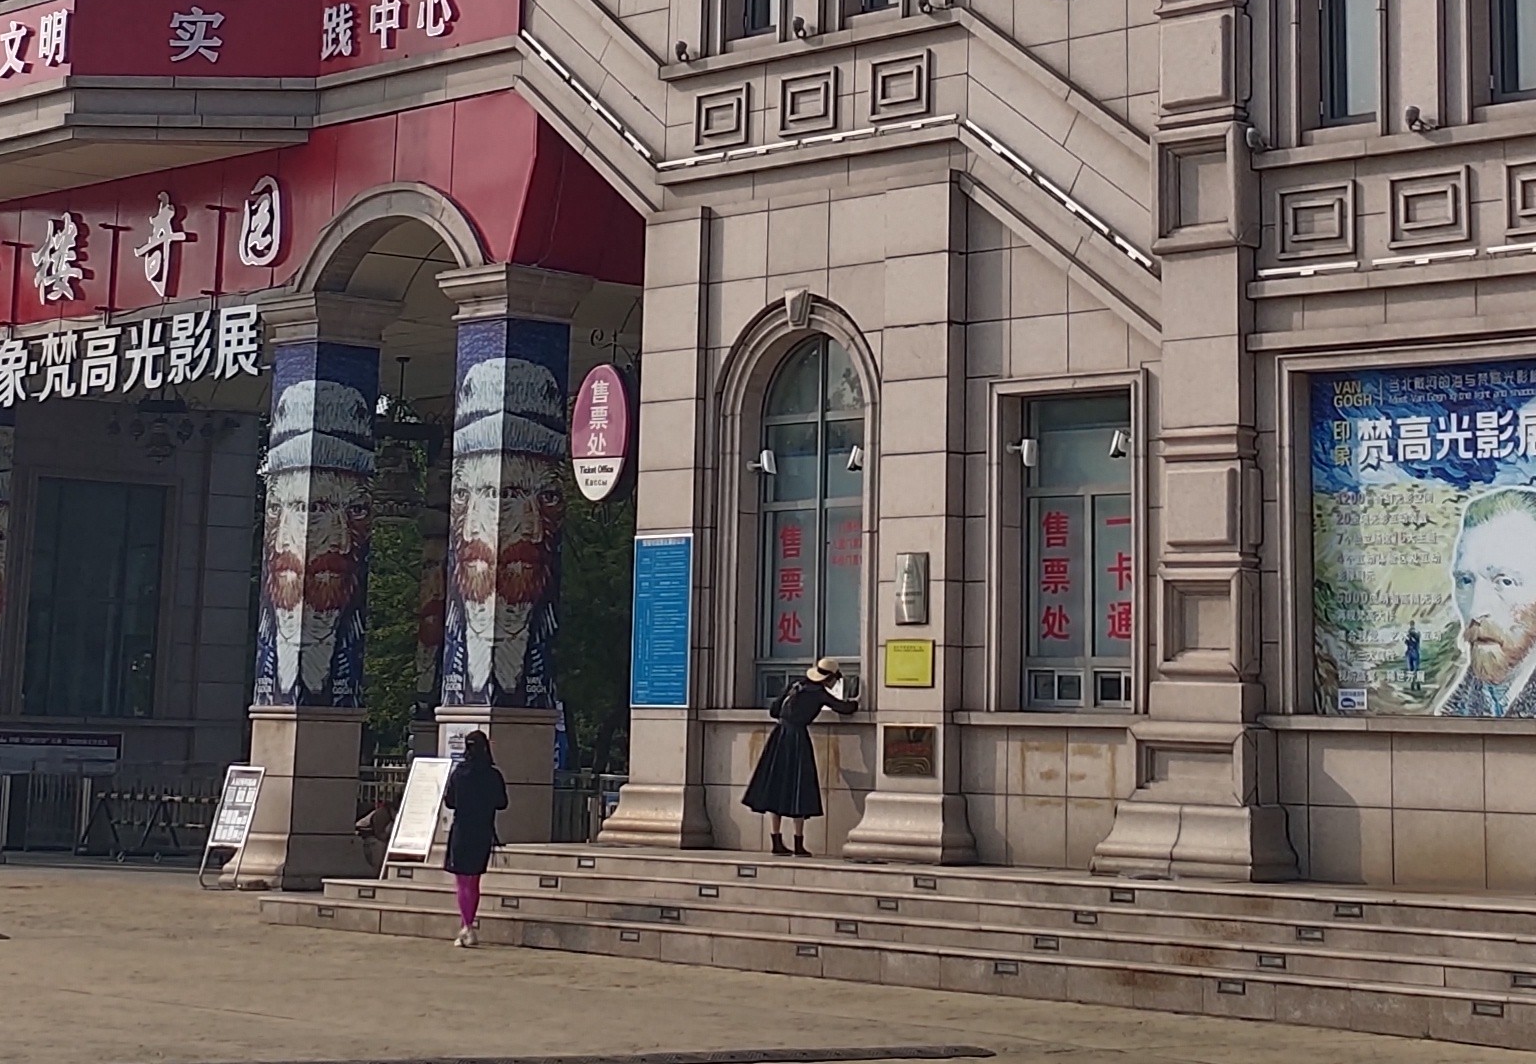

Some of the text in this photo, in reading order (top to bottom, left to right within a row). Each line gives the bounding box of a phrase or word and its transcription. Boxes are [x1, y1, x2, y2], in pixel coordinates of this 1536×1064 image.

[168, 6, 225, 63] 实
[1333, 381, 1362, 394] VAN
[1333, 394, 1373, 408] GOGH
[587, 380, 610, 456] 售票处
[1333, 420, 1352, 466] 印象
[580, 464, 614, 475] Ticket Office
[778, 524, 803, 643] 售票处
[1040, 511, 1070, 640] 售票处
[1106, 517, 1132, 640] 一卡通
